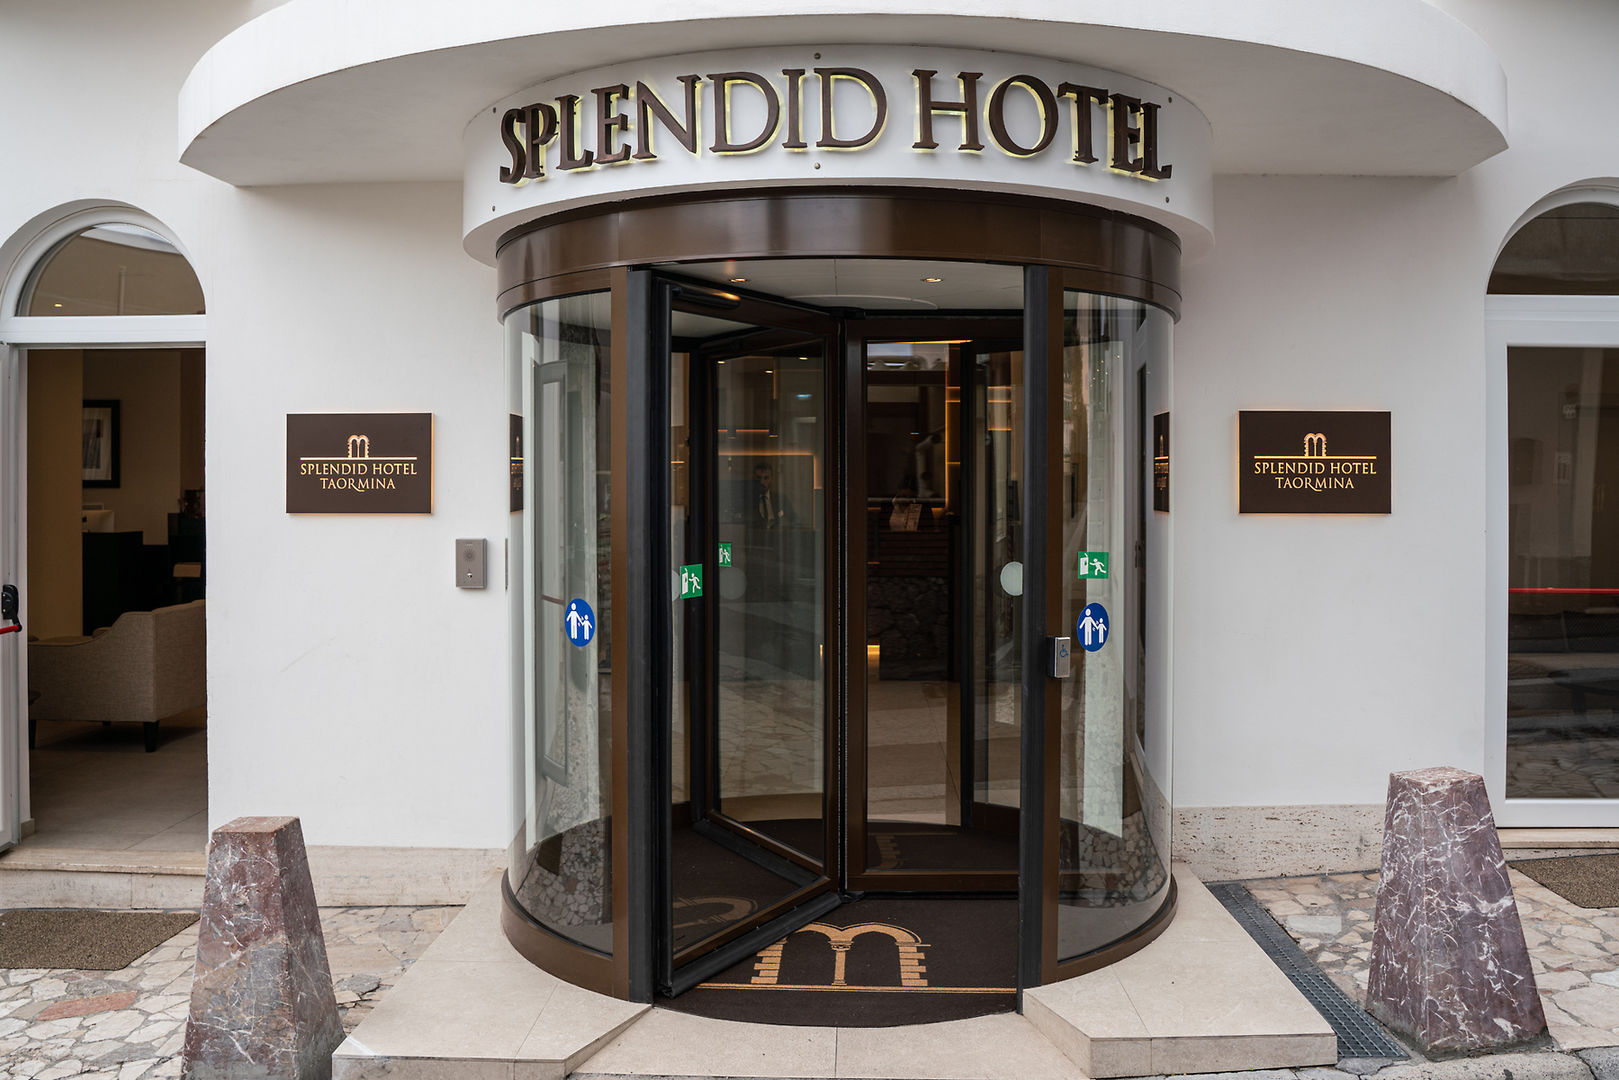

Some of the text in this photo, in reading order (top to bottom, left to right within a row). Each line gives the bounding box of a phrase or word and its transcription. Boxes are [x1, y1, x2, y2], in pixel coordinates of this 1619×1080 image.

[500, 67, 1172, 184] SPLENDID HOTEL
[300, 463, 417, 475] SPLENDID HOTEL
[1254, 461, 1377, 475] SPLENDID HOTEL
[320, 477, 396, 492] TAORMINA
[1275, 477, 1354, 492] TAORMINA
